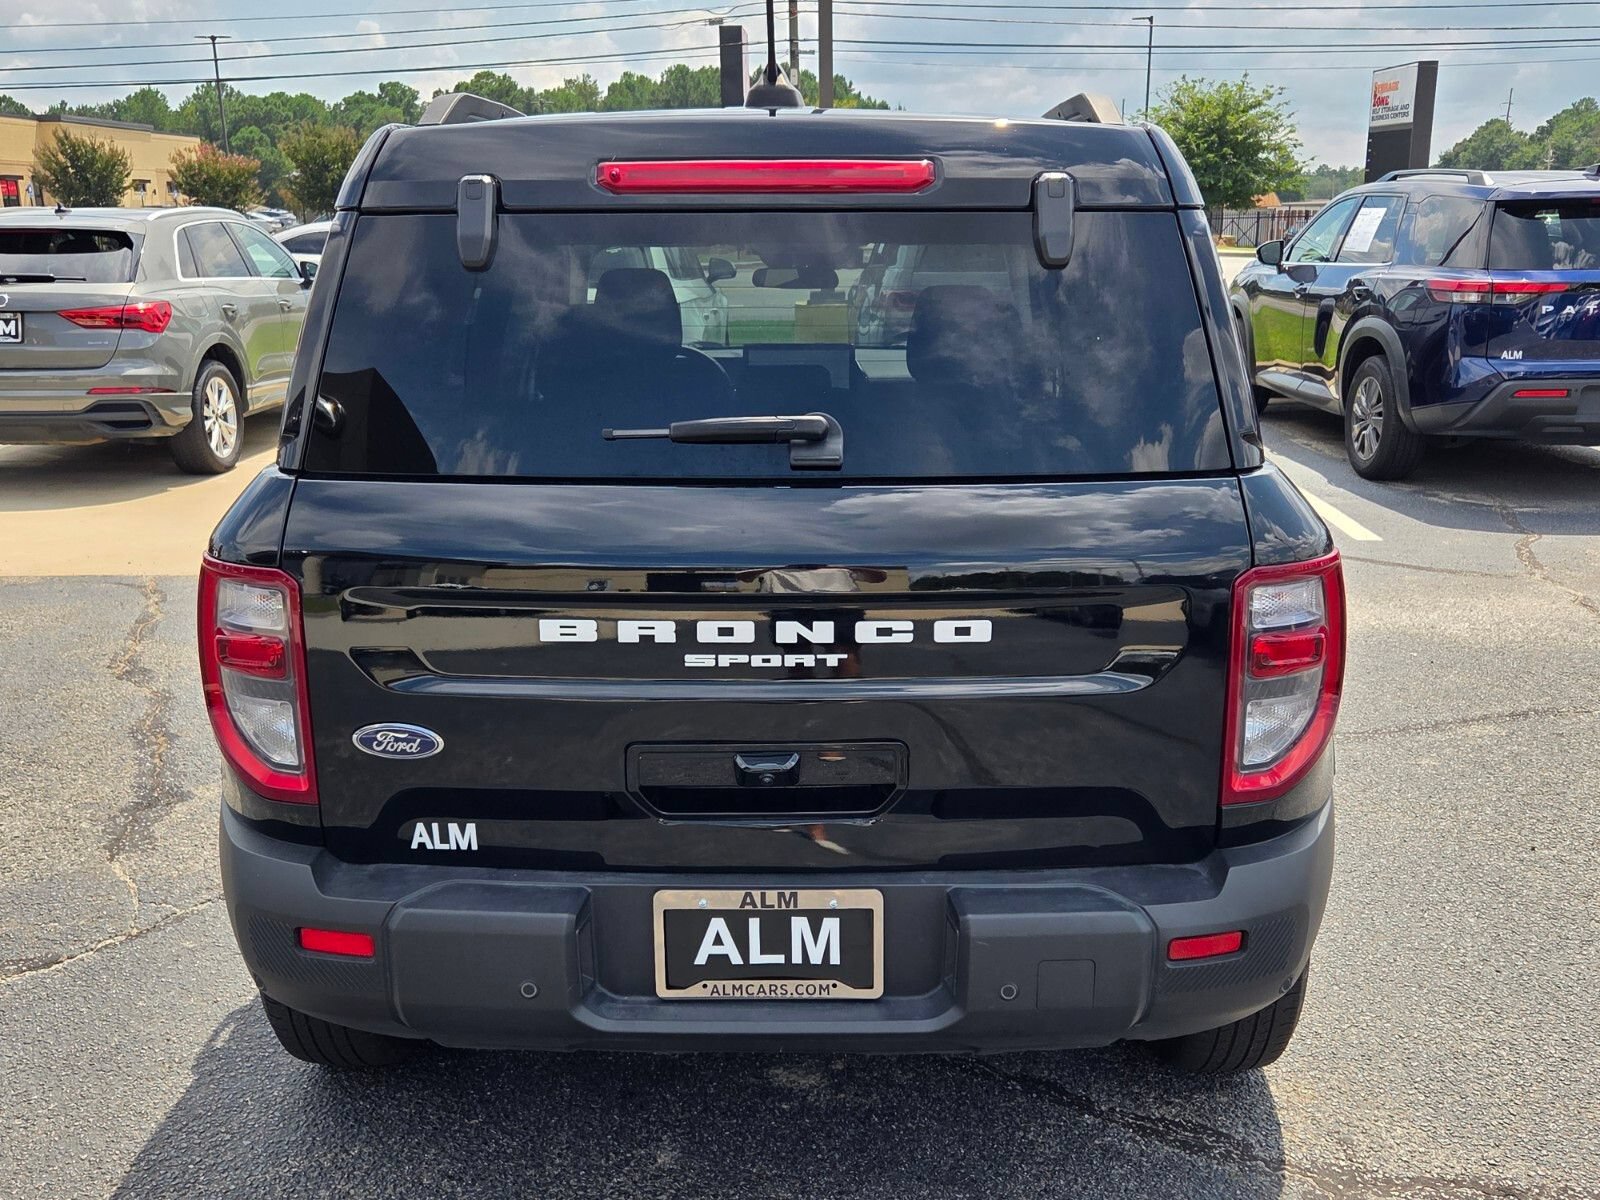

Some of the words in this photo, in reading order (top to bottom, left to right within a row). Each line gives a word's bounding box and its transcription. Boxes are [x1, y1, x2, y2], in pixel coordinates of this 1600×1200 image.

[1390, 111, 1409, 119] CENTERS
[1500, 350, 1523, 360] ALM
[538, 619, 993, 643] BRONCO
[684, 654, 848, 667] SPORT
[372, 731, 421, 753] Ford
[410, 822, 478, 850] ALM
[739, 891, 798, 909] ALM
[693, 916, 841, 965] ALM
[710, 983, 830, 996] ALMCARS.COM
